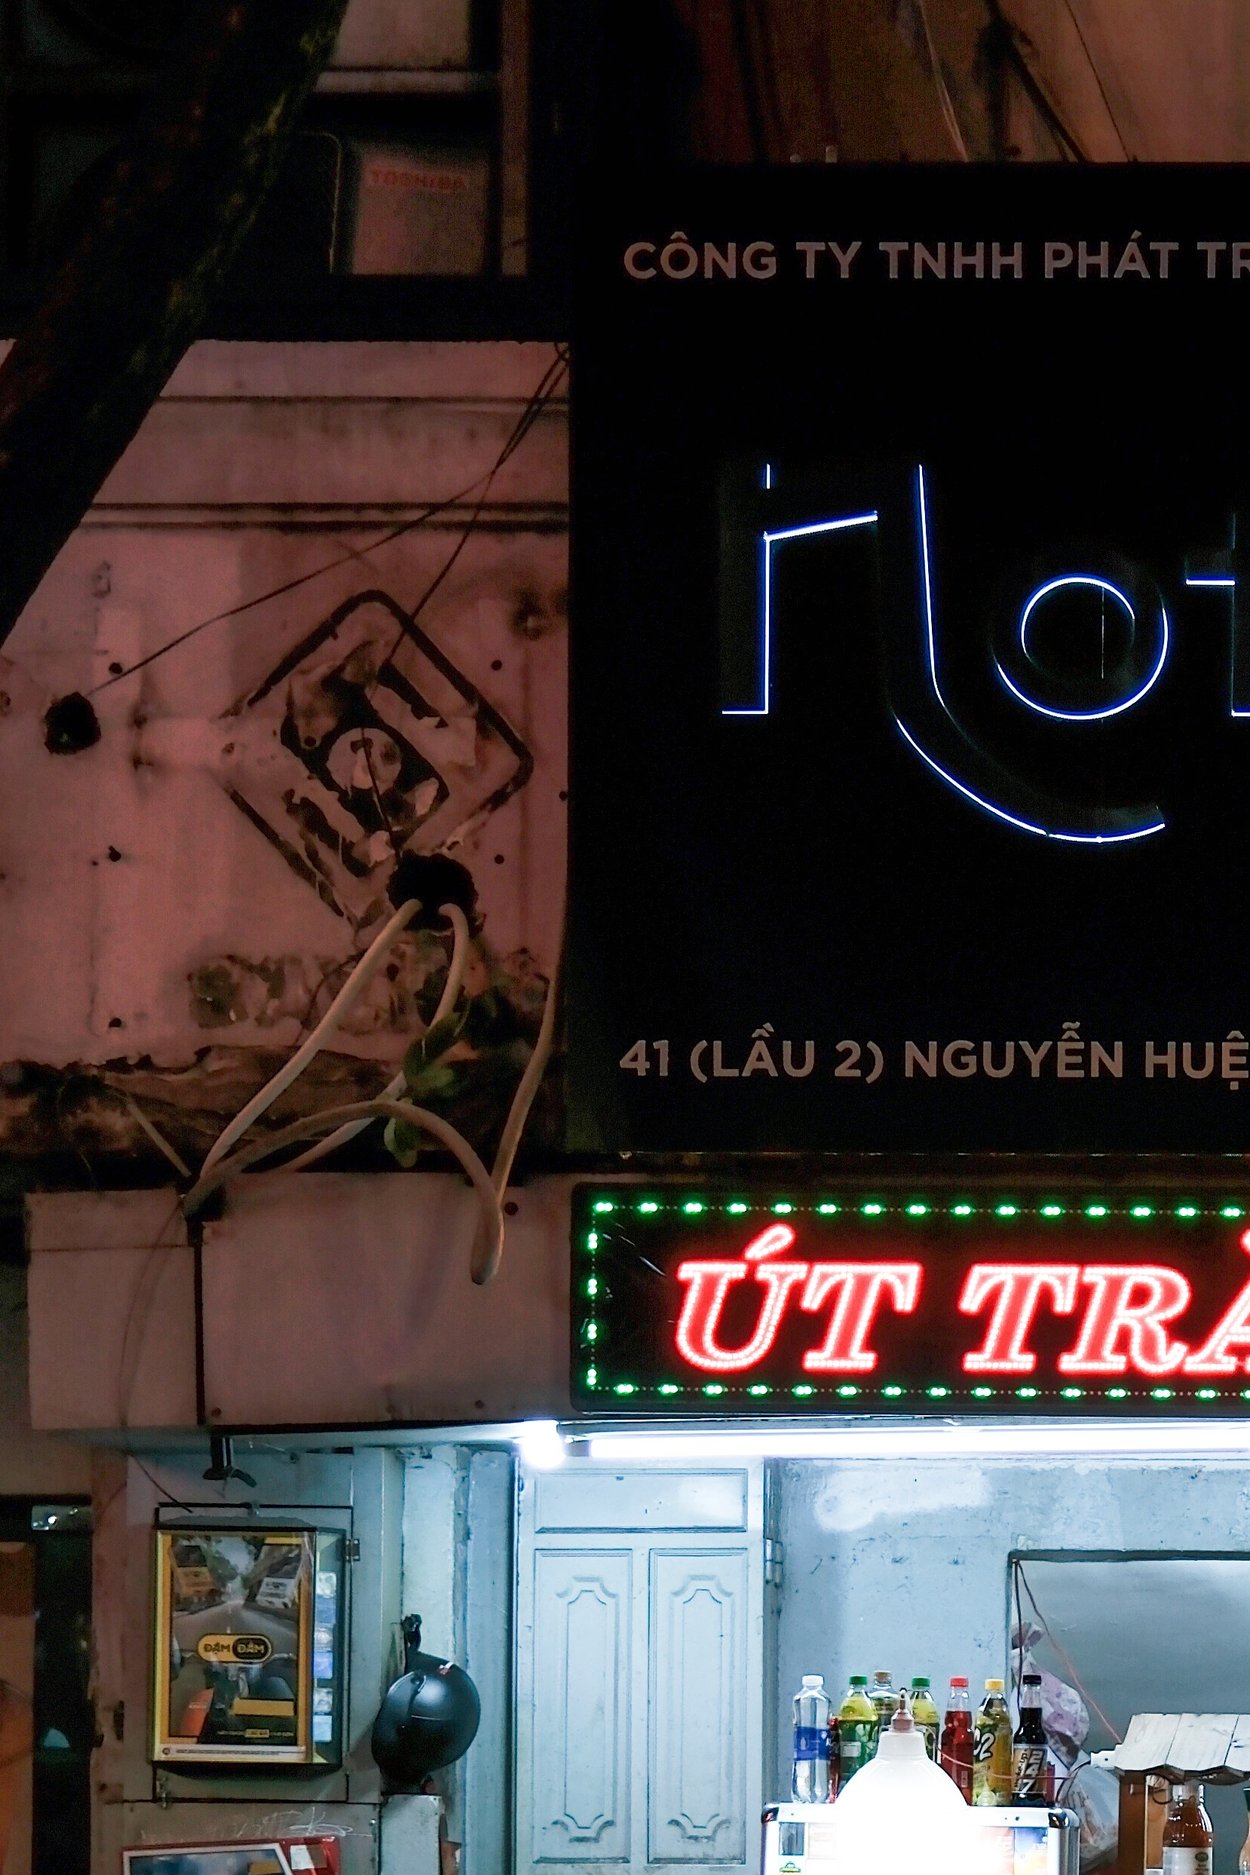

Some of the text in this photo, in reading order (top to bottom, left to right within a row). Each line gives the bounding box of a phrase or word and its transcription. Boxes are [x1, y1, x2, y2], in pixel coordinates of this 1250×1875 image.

[622, 231, 778, 281] CÔNG
[795, 241, 863, 280] TY
[878, 241, 1024, 280] TNHH
[1043, 230, 1180, 280] PHÁT
[618, 1038, 671, 1078] 41
[689, 1022, 816, 1085] (LẦU
[833, 1038, 886, 1085] 2)
[903, 1020, 1125, 1080] NGUYỄN
[672, 1222, 924, 1373] ÚT
